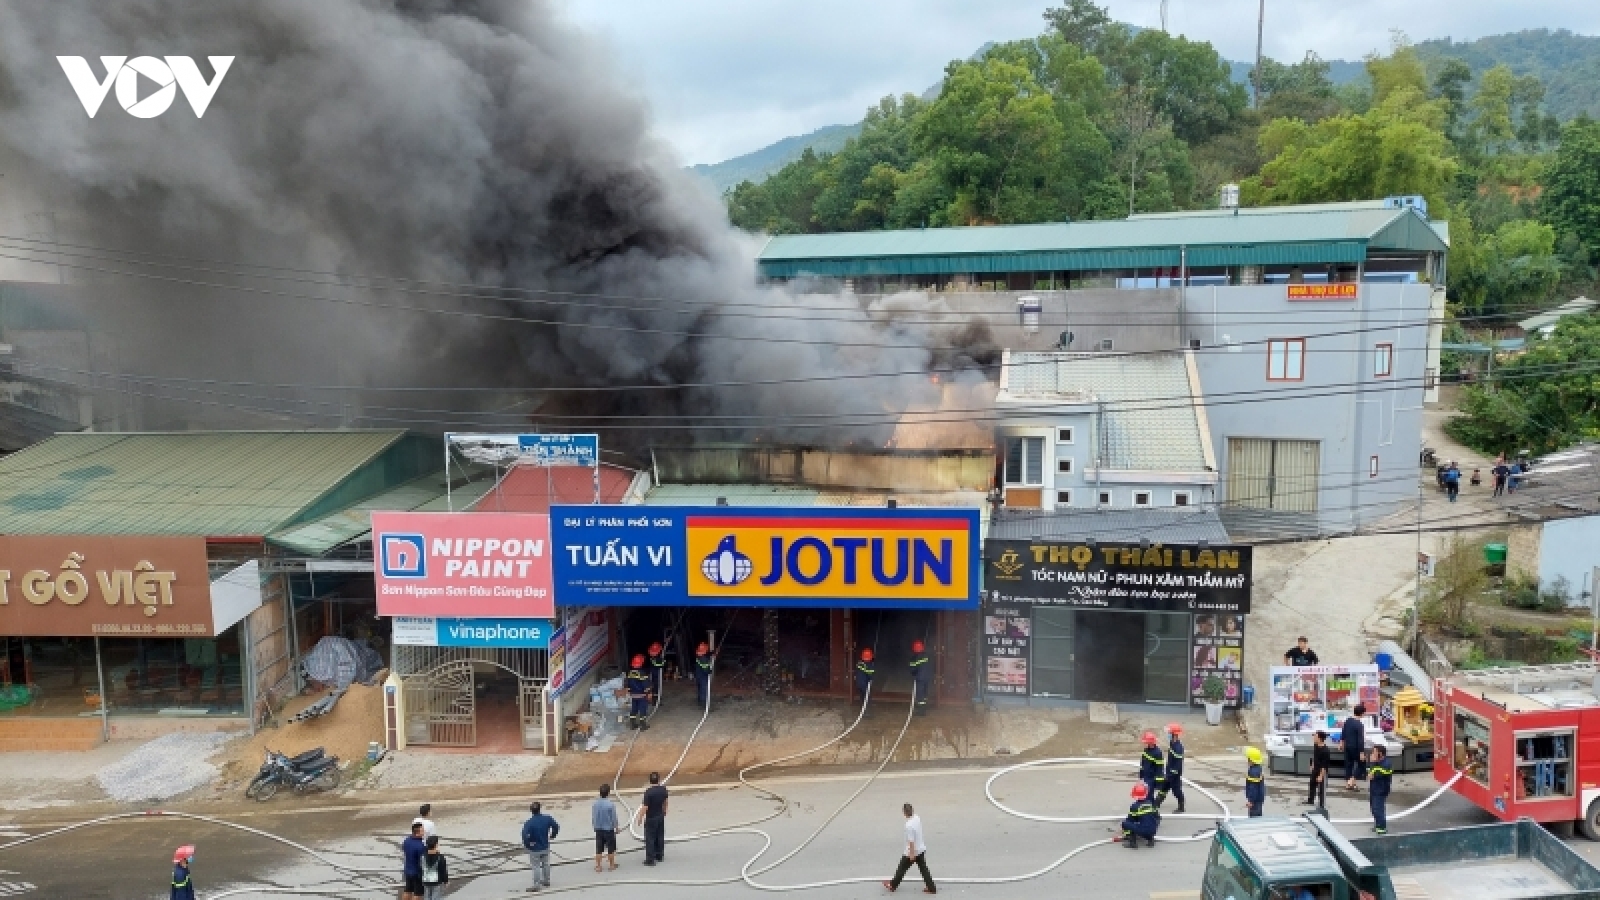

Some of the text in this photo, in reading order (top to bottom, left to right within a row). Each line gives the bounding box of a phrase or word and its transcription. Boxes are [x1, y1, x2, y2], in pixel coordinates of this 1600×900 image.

[431, 538, 545, 557] NIPPON
[565, 538, 672, 567] TUẤN VI
[1029, 542, 1241, 570] THỌ THÁI LAN
[445, 559, 533, 578] PAINT
[759, 535, 953, 586] JOTUN
[21, 551, 89, 605] GỖ
[95, 559, 177, 617] VIỆT
[1031, 567, 1055, 581] TÓC
[1057, 571, 1087, 583] NAM
[1116, 573, 1153, 586] PHUN
[405, 585, 444, 598] Nippon
[449, 623, 541, 640] vinaphone
